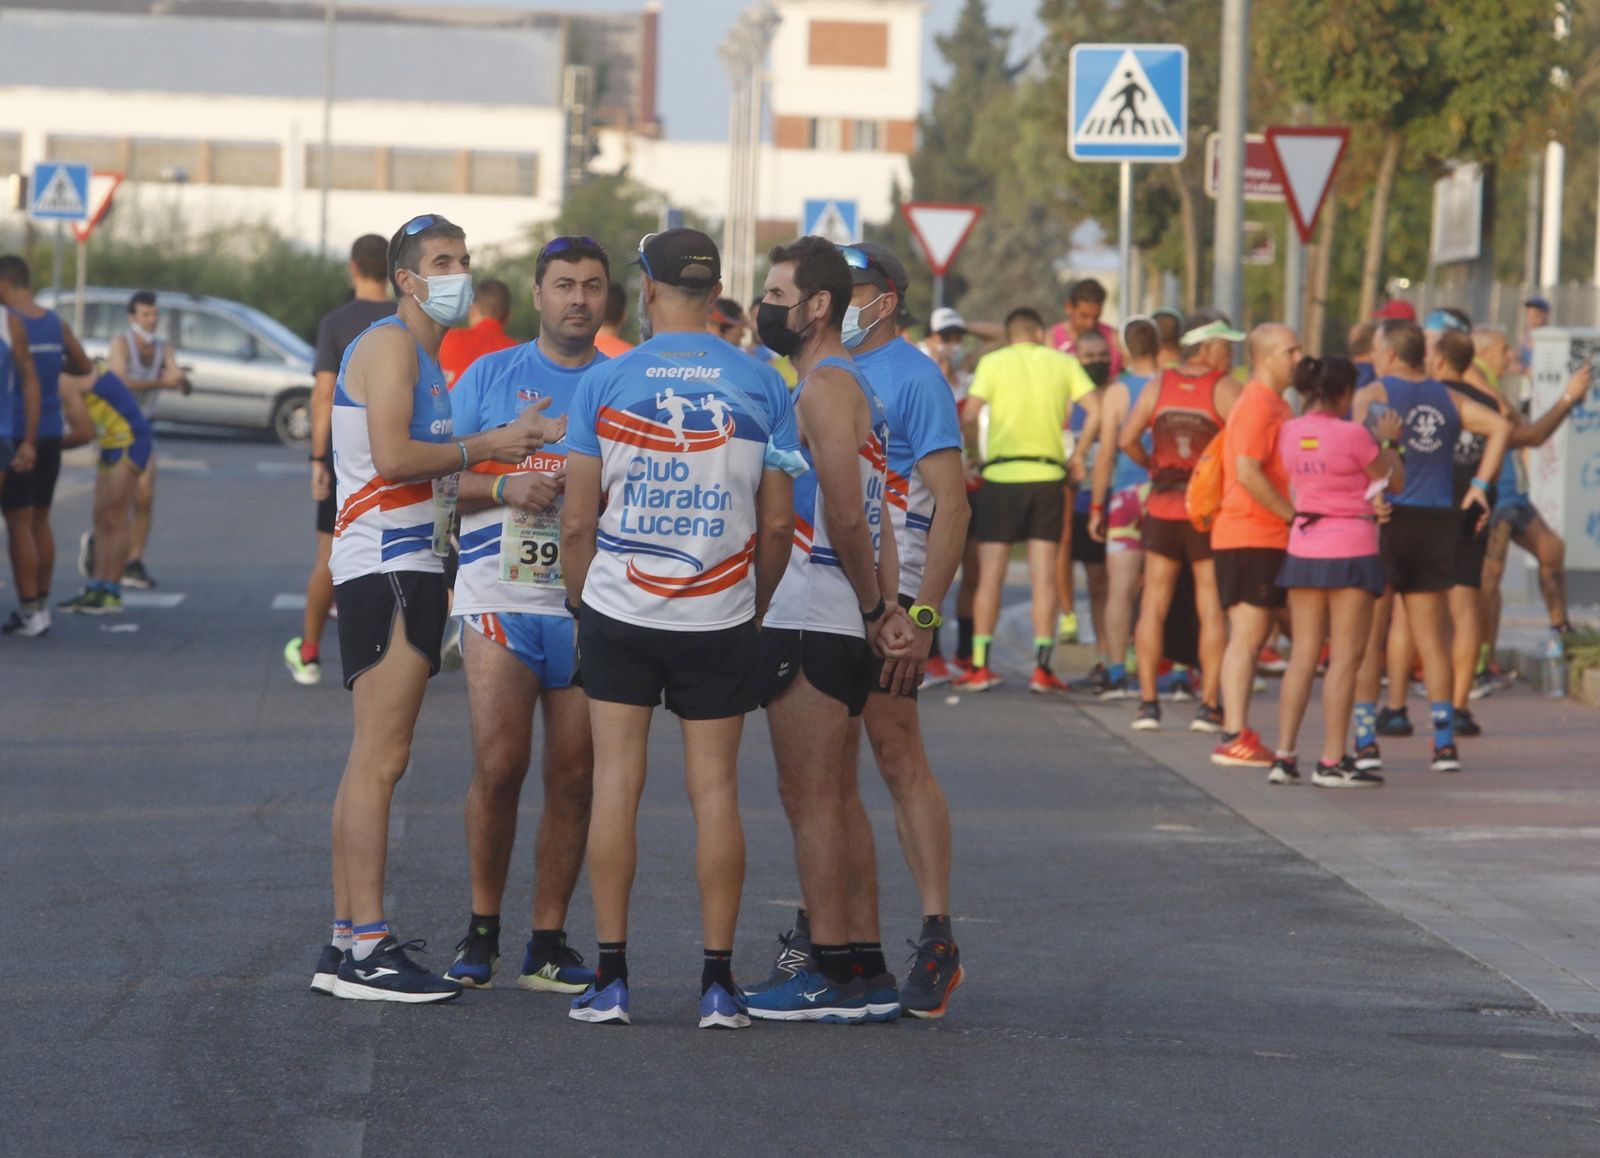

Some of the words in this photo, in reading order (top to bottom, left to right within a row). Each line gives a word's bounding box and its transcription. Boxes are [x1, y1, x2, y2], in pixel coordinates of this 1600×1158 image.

[645, 366, 722, 381] enerplus
[626, 456, 690, 482] Club
[623, 482, 733, 511] Maratón
[620, 508, 725, 537] Lucena
[520, 540, 559, 567] 39
